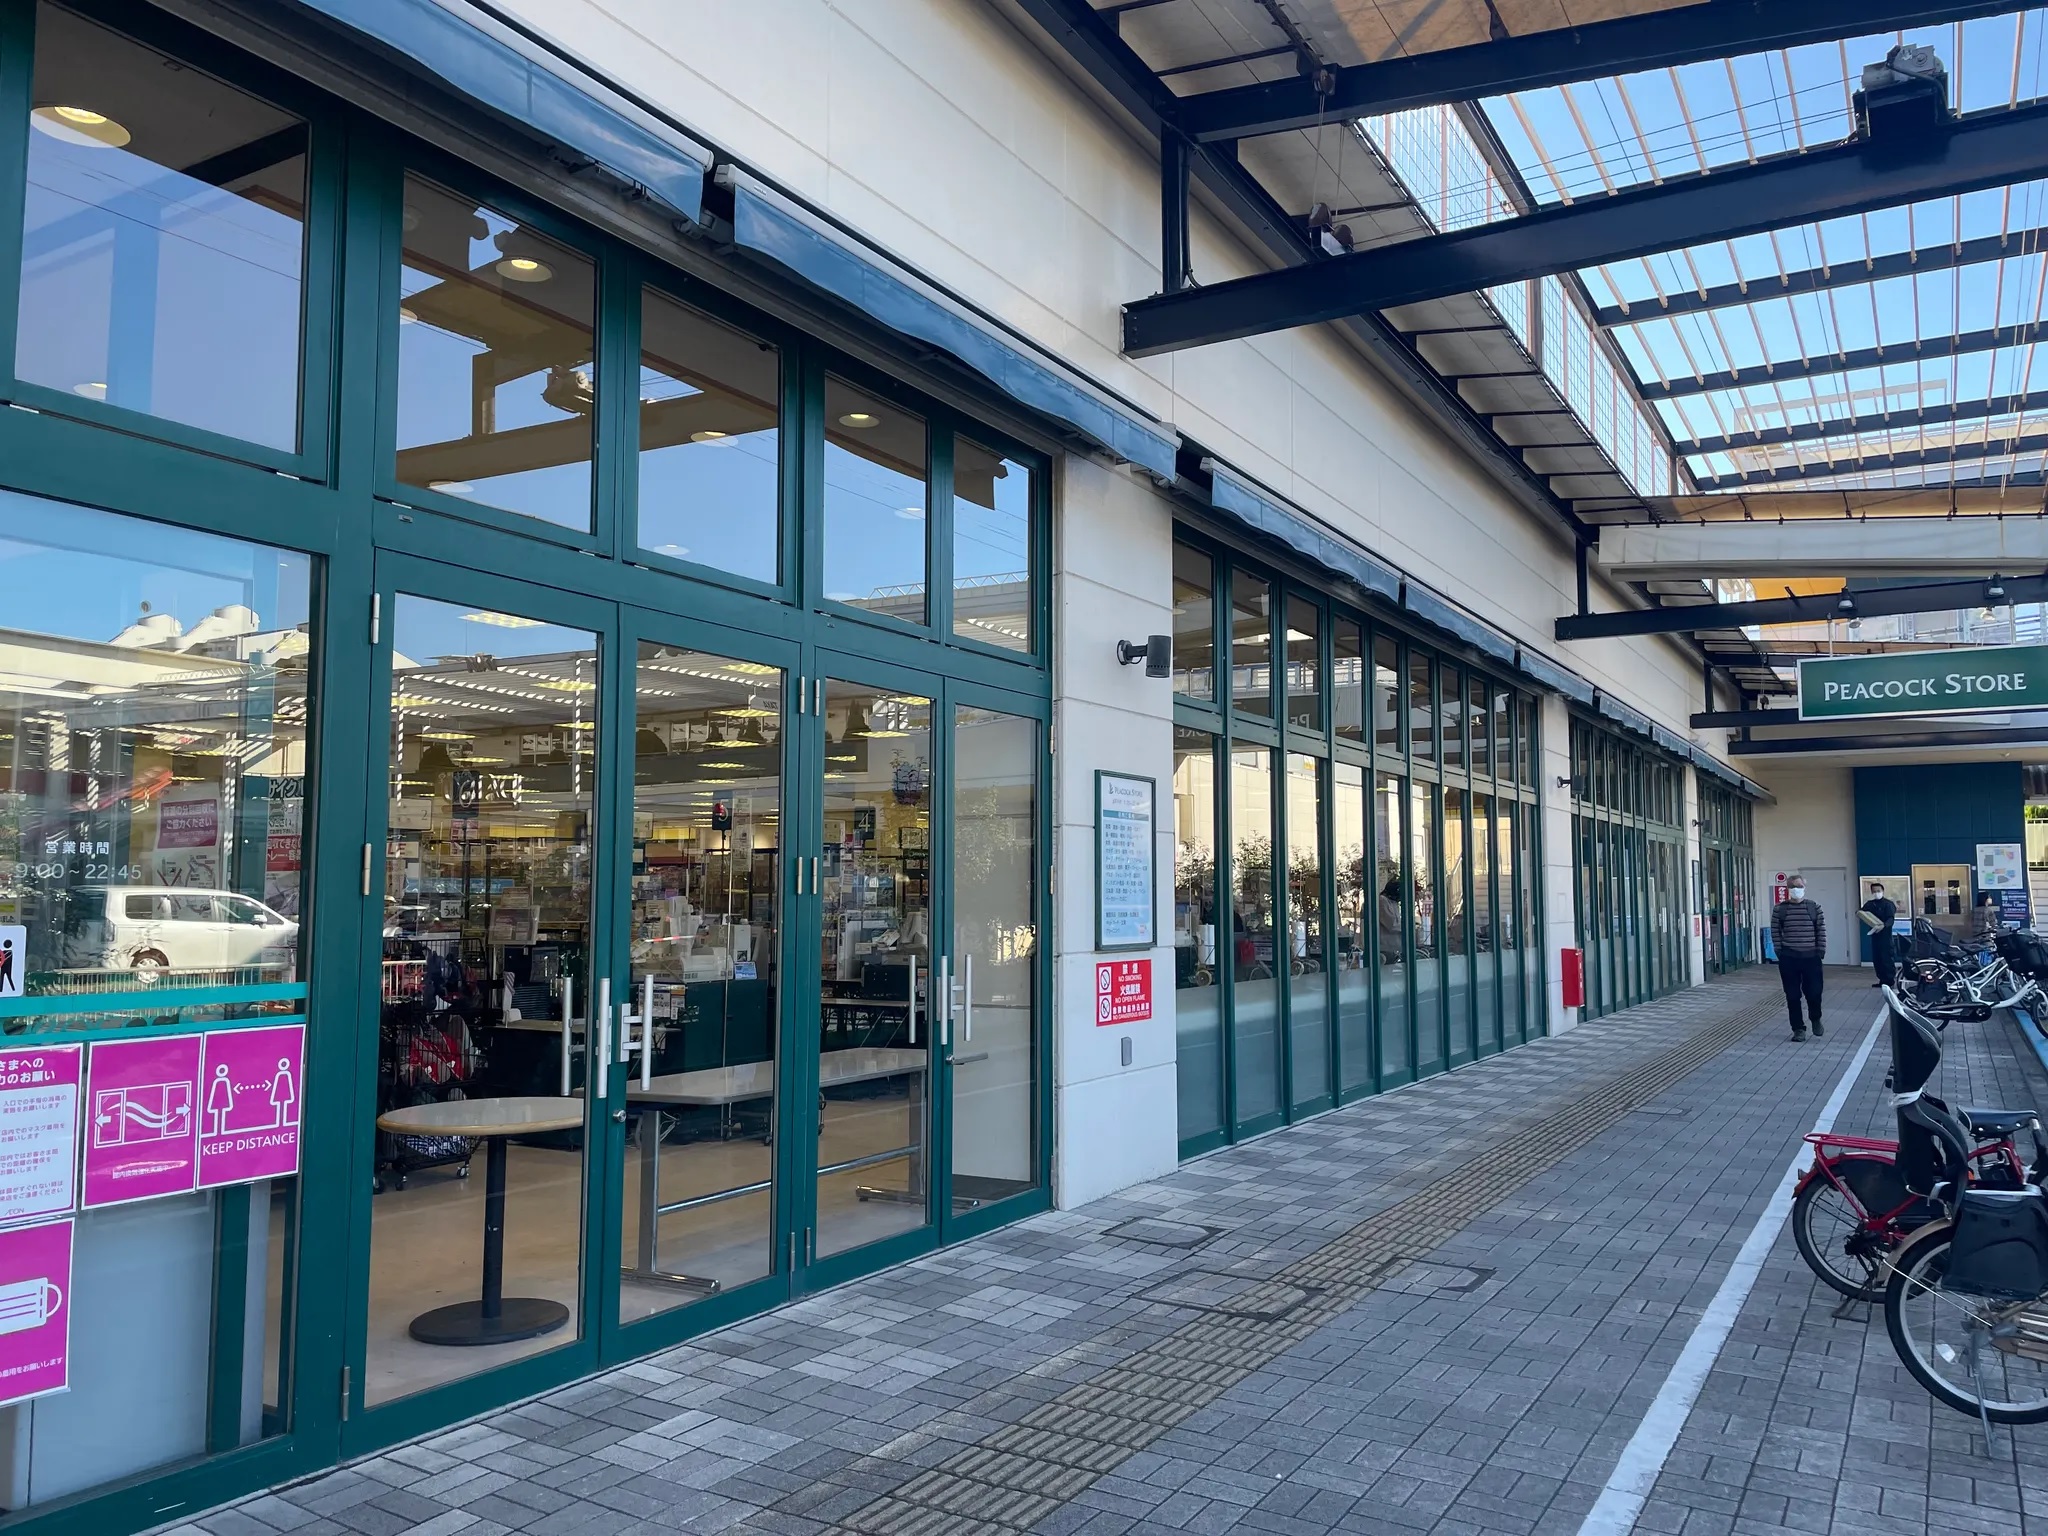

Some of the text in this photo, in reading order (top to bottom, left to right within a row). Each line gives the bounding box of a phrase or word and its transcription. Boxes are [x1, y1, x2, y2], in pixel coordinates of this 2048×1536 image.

[1823, 673, 2027, 701] PEACOCK STORE
[858, 812, 871, 832] 4
[45, 841, 109, 855] 営業時間
[1, 1132, 39, 1143] お願いします
[202, 1132, 296, 1156] KEEP DISTANCE
[0, 1165, 38, 1175] お願いします
